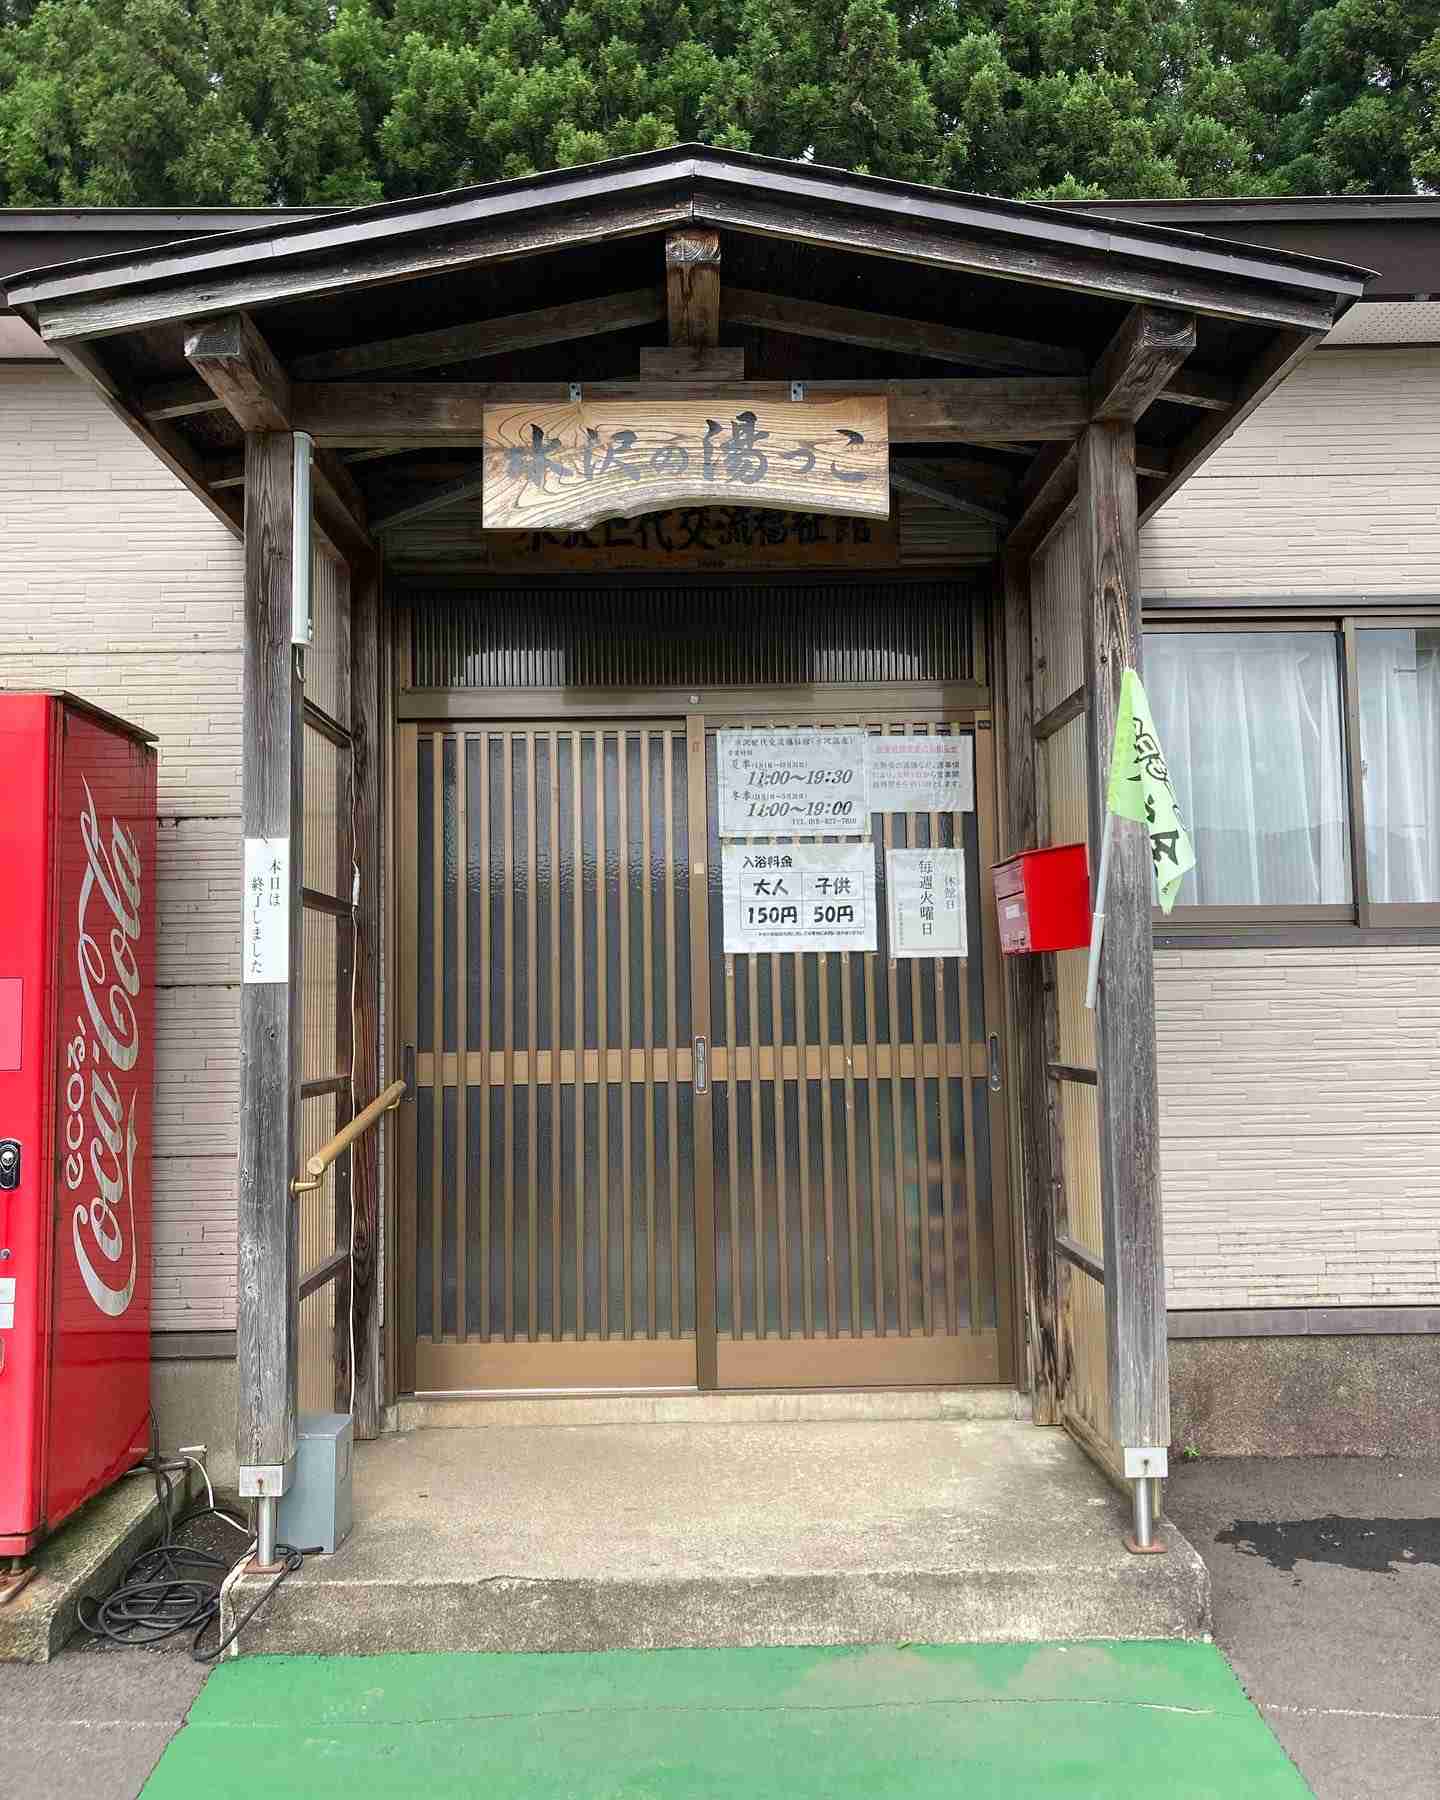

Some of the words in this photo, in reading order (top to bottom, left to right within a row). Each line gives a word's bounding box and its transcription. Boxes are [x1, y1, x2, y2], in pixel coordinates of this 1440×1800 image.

[742, 855, 793, 869] 入浴料金
[269, 857, 282, 907] 本日は
[753, 878, 789, 896] 大人
[814, 877, 851, 895] 子供
[919, 859, 935, 937] 毎週火曜日
[748, 905, 798, 924] 150円
[813, 904, 854, 924] 50円
[73, 773, 143, 1317] Coca-Cola
